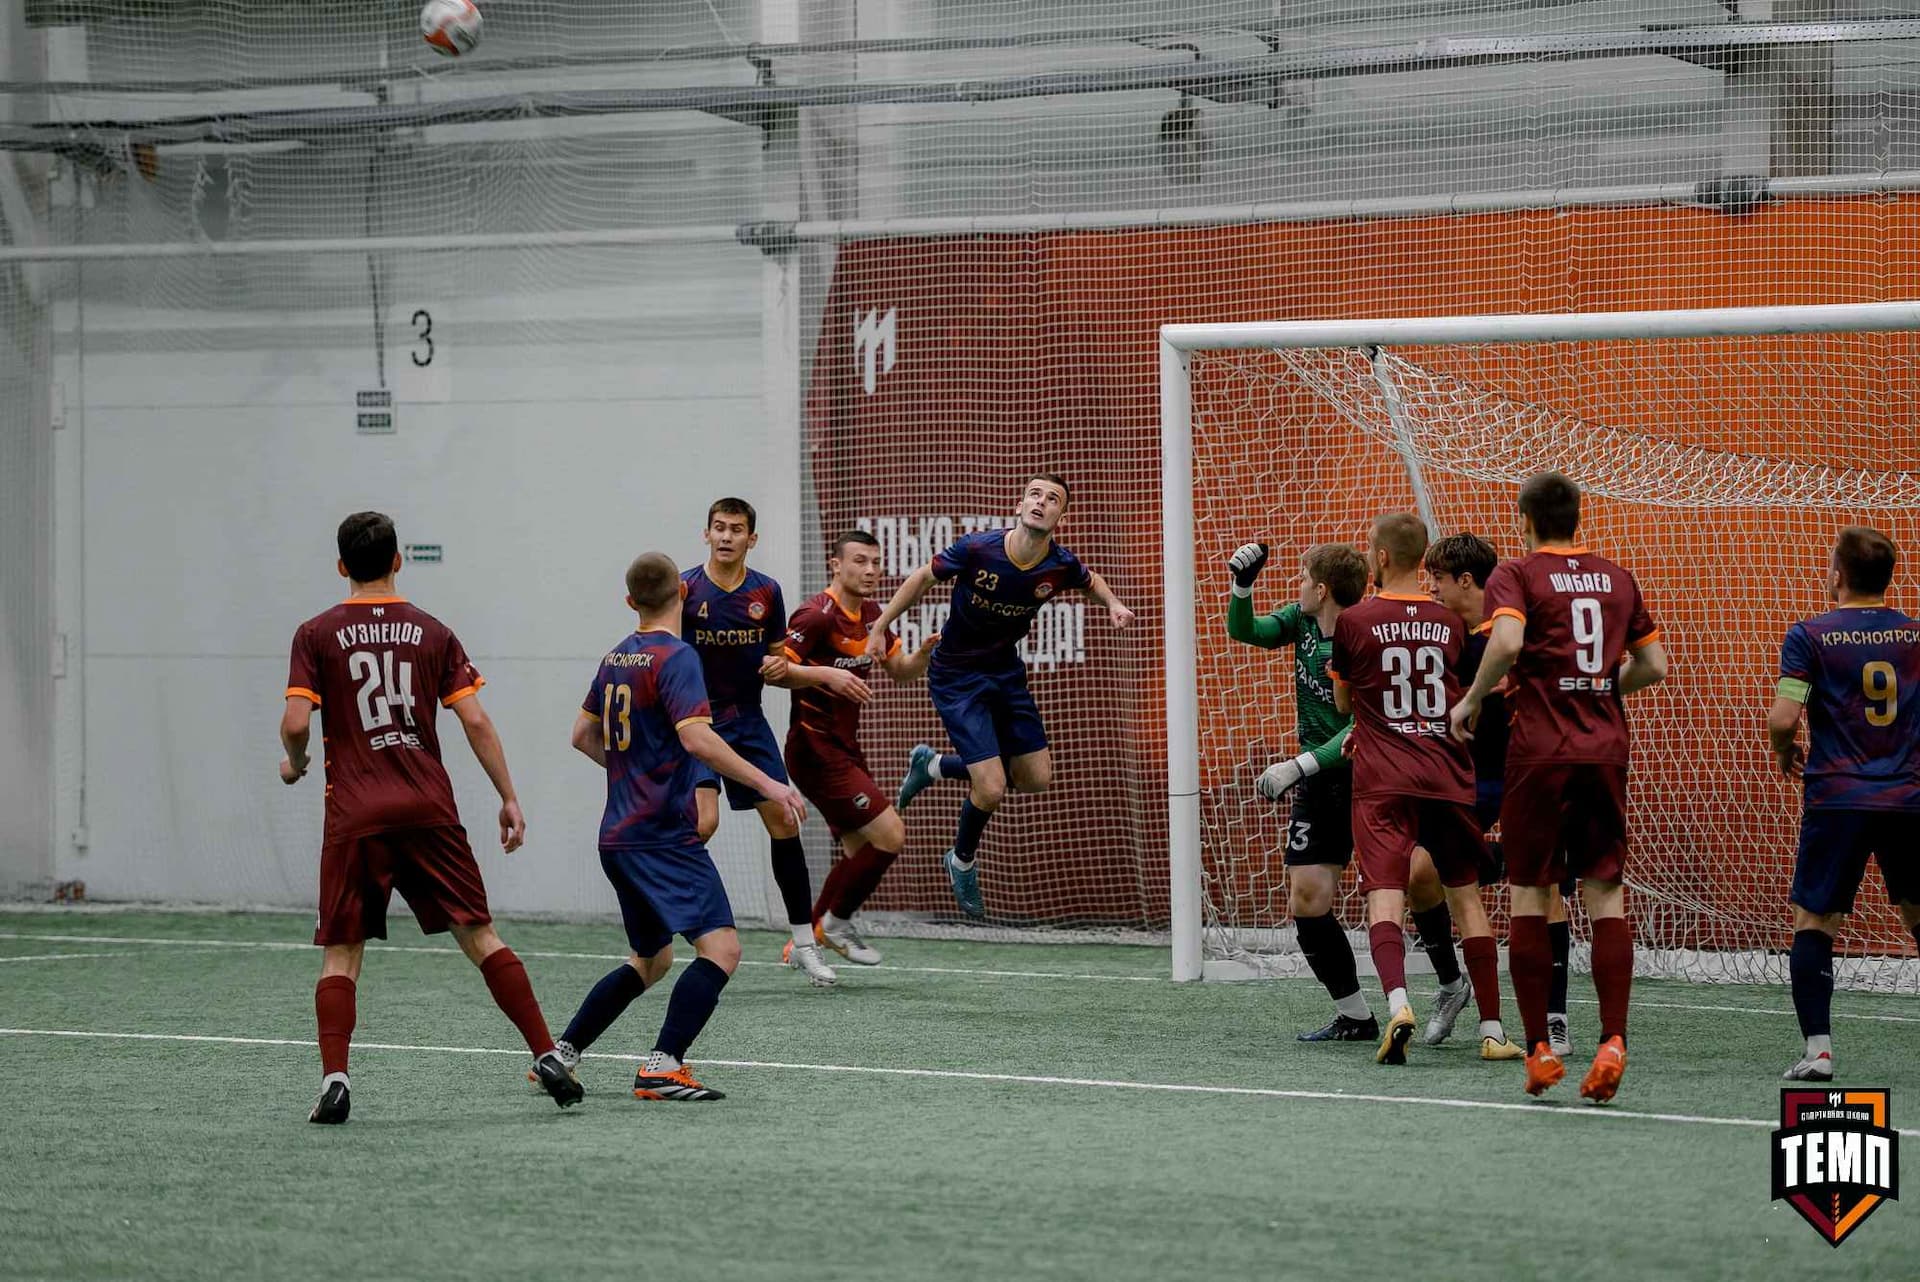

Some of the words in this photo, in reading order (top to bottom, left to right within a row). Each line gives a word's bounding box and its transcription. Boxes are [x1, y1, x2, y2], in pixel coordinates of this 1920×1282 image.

[412, 310, 434, 367] 3
[975, 569, 999, 591] 23
[1550, 573, 1611, 593] ШИБАЕВ
[698, 600, 708, 619] 4
[336, 622, 423, 650] КУЗНЕЦОВ
[696, 627, 767, 646] РАССВЕТ
[1371, 621, 1451, 644] ЧЕРКАСОВ
[1571, 598, 1603, 674] 9
[1821, 629, 1920, 647] КРАСНОЯРСК
[349, 650, 416, 732] 24
[1381, 646, 1447, 719] 33
[1862, 661, 1899, 727] 9
[603, 683, 632, 751] 13
